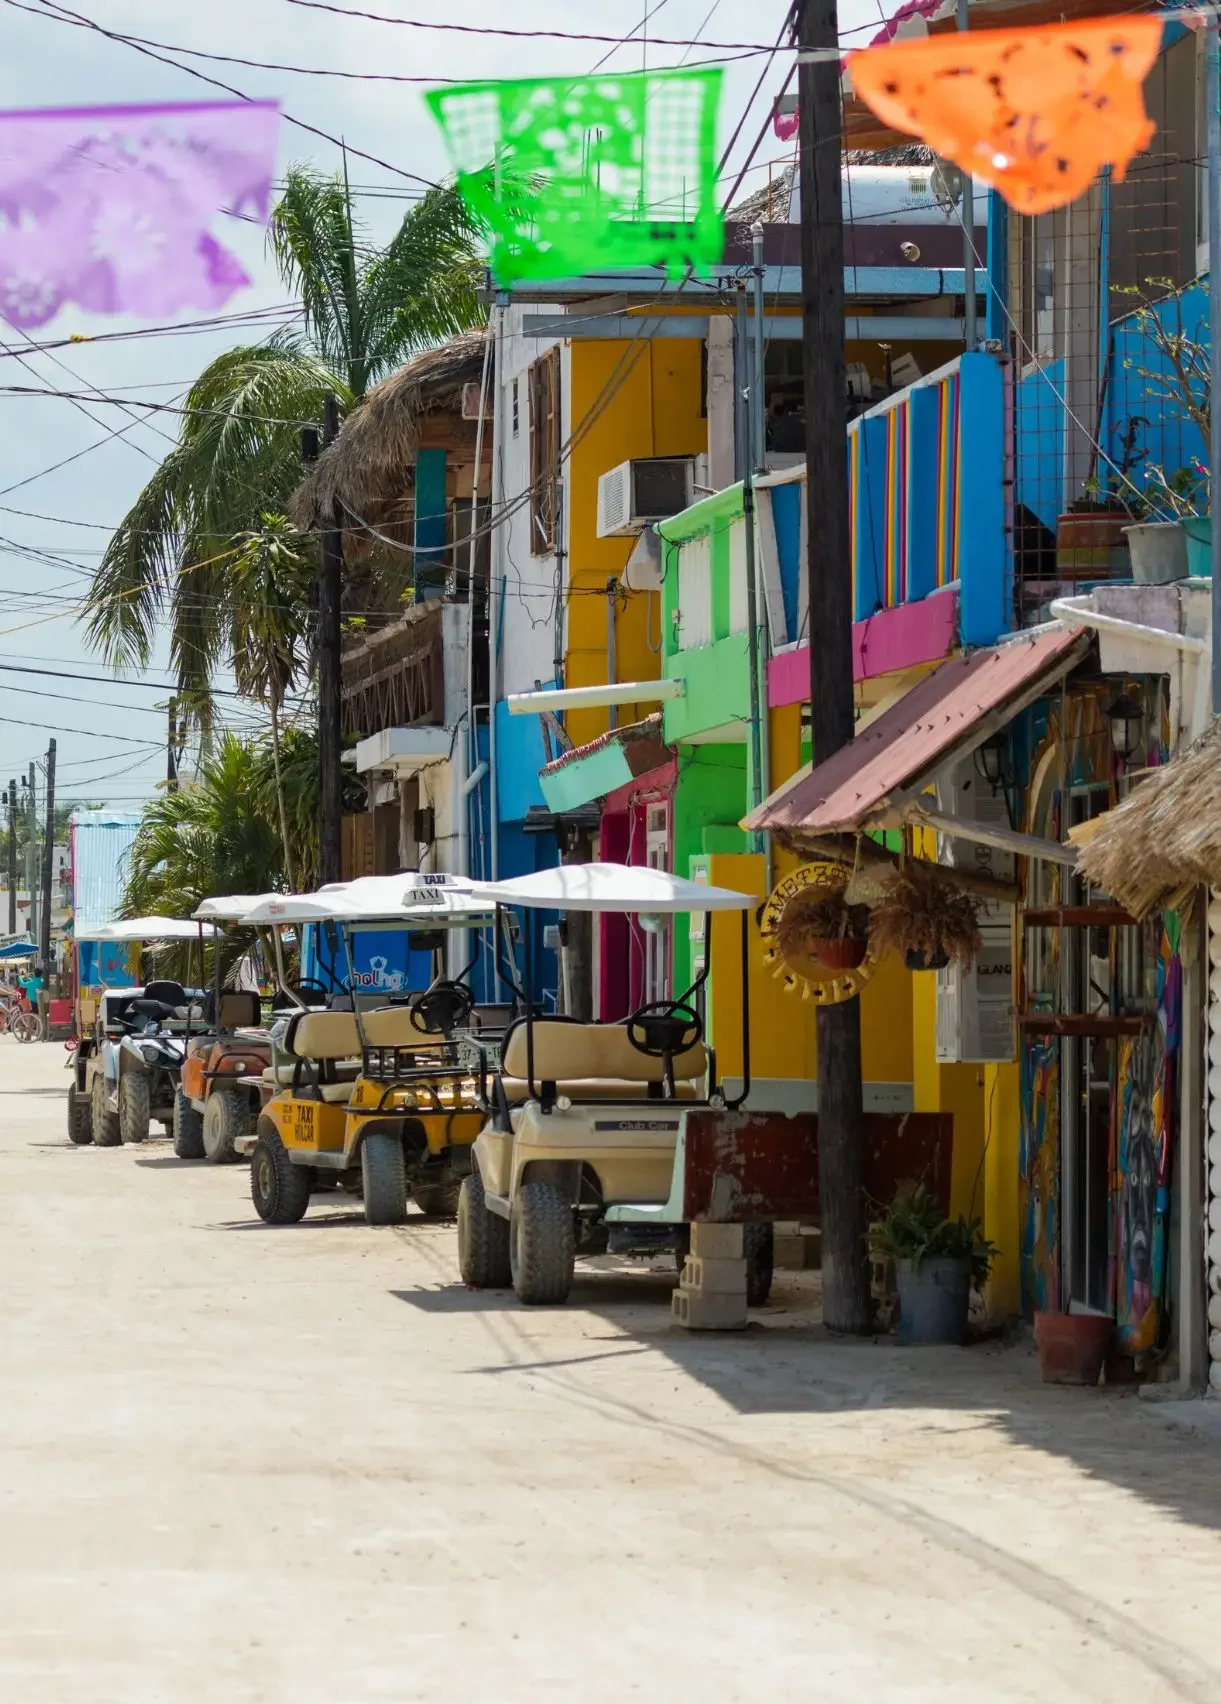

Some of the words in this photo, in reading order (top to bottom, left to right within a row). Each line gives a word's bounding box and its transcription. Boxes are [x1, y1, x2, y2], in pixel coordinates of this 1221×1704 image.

[423, 875, 446, 885] TAXI
[410, 887, 439, 901] TAXI
[297, 1105, 314, 1123] TAXI
[618, 1120, 645, 1130] Club
[648, 1121, 670, 1130] Car
